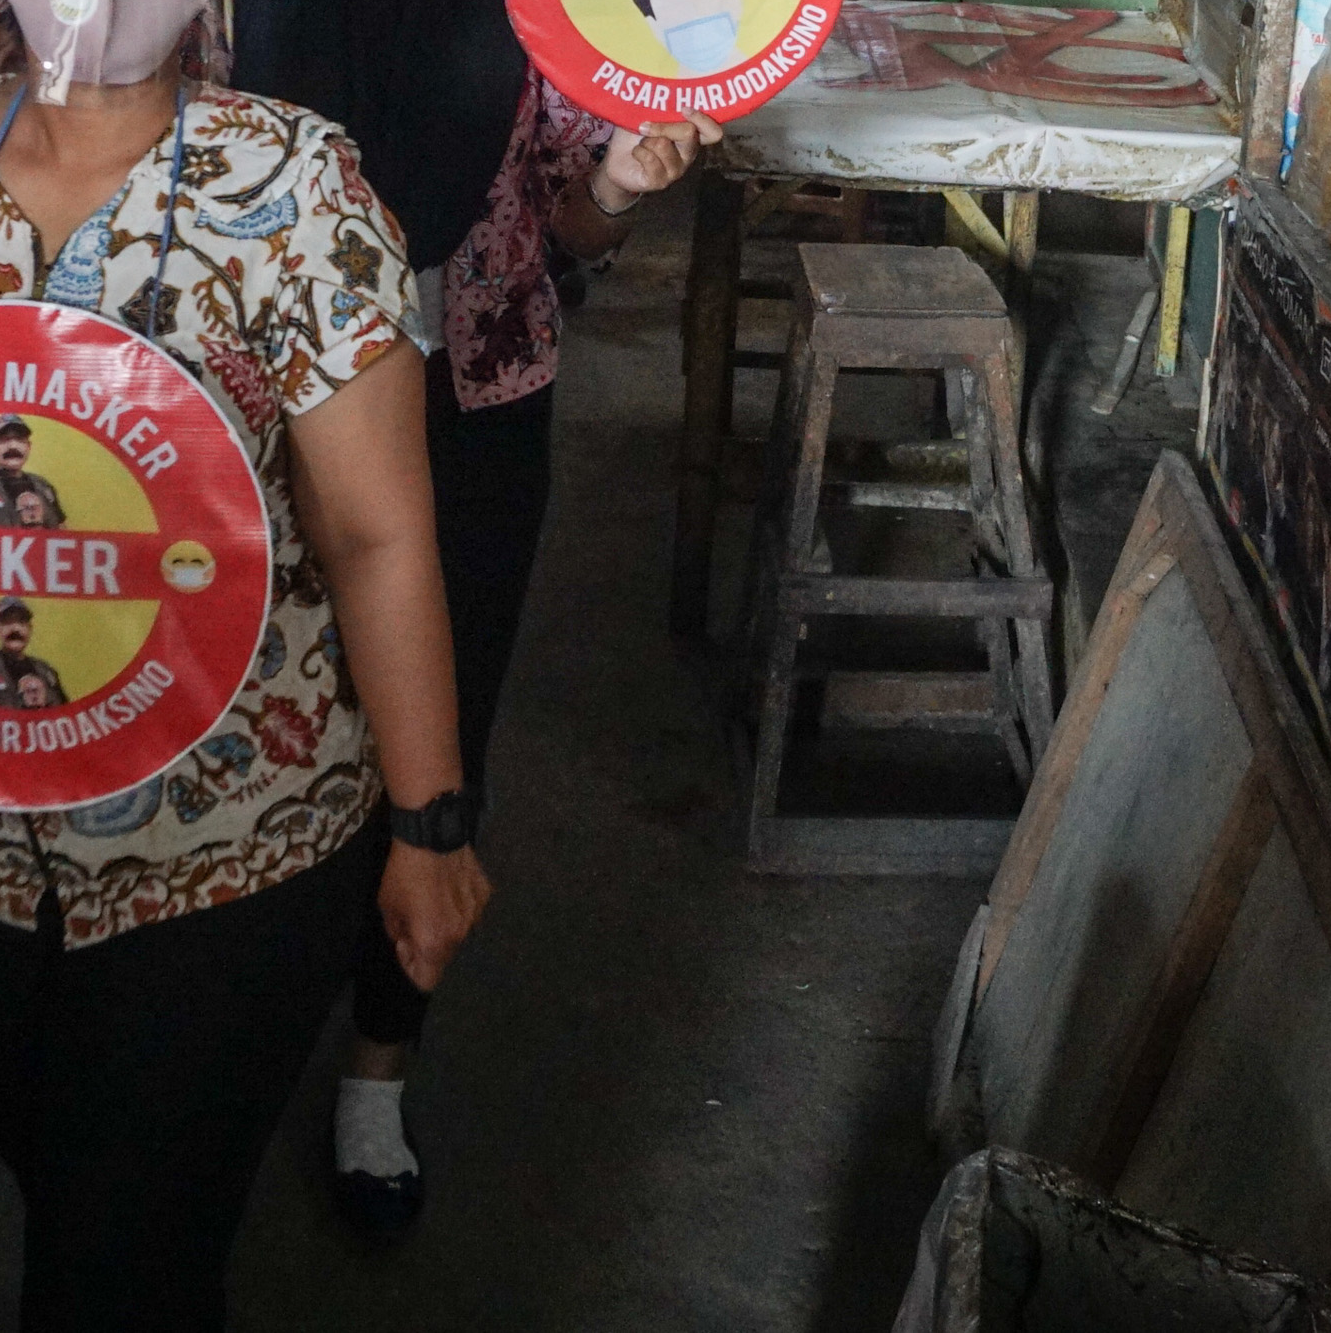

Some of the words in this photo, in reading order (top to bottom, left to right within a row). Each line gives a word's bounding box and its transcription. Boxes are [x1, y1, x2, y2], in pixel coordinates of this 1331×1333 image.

[591, 60, 670, 113] PASAR
[675, 2, 827, 113] HARJODAKSINO
[4, 362, 180, 481] MASKER
